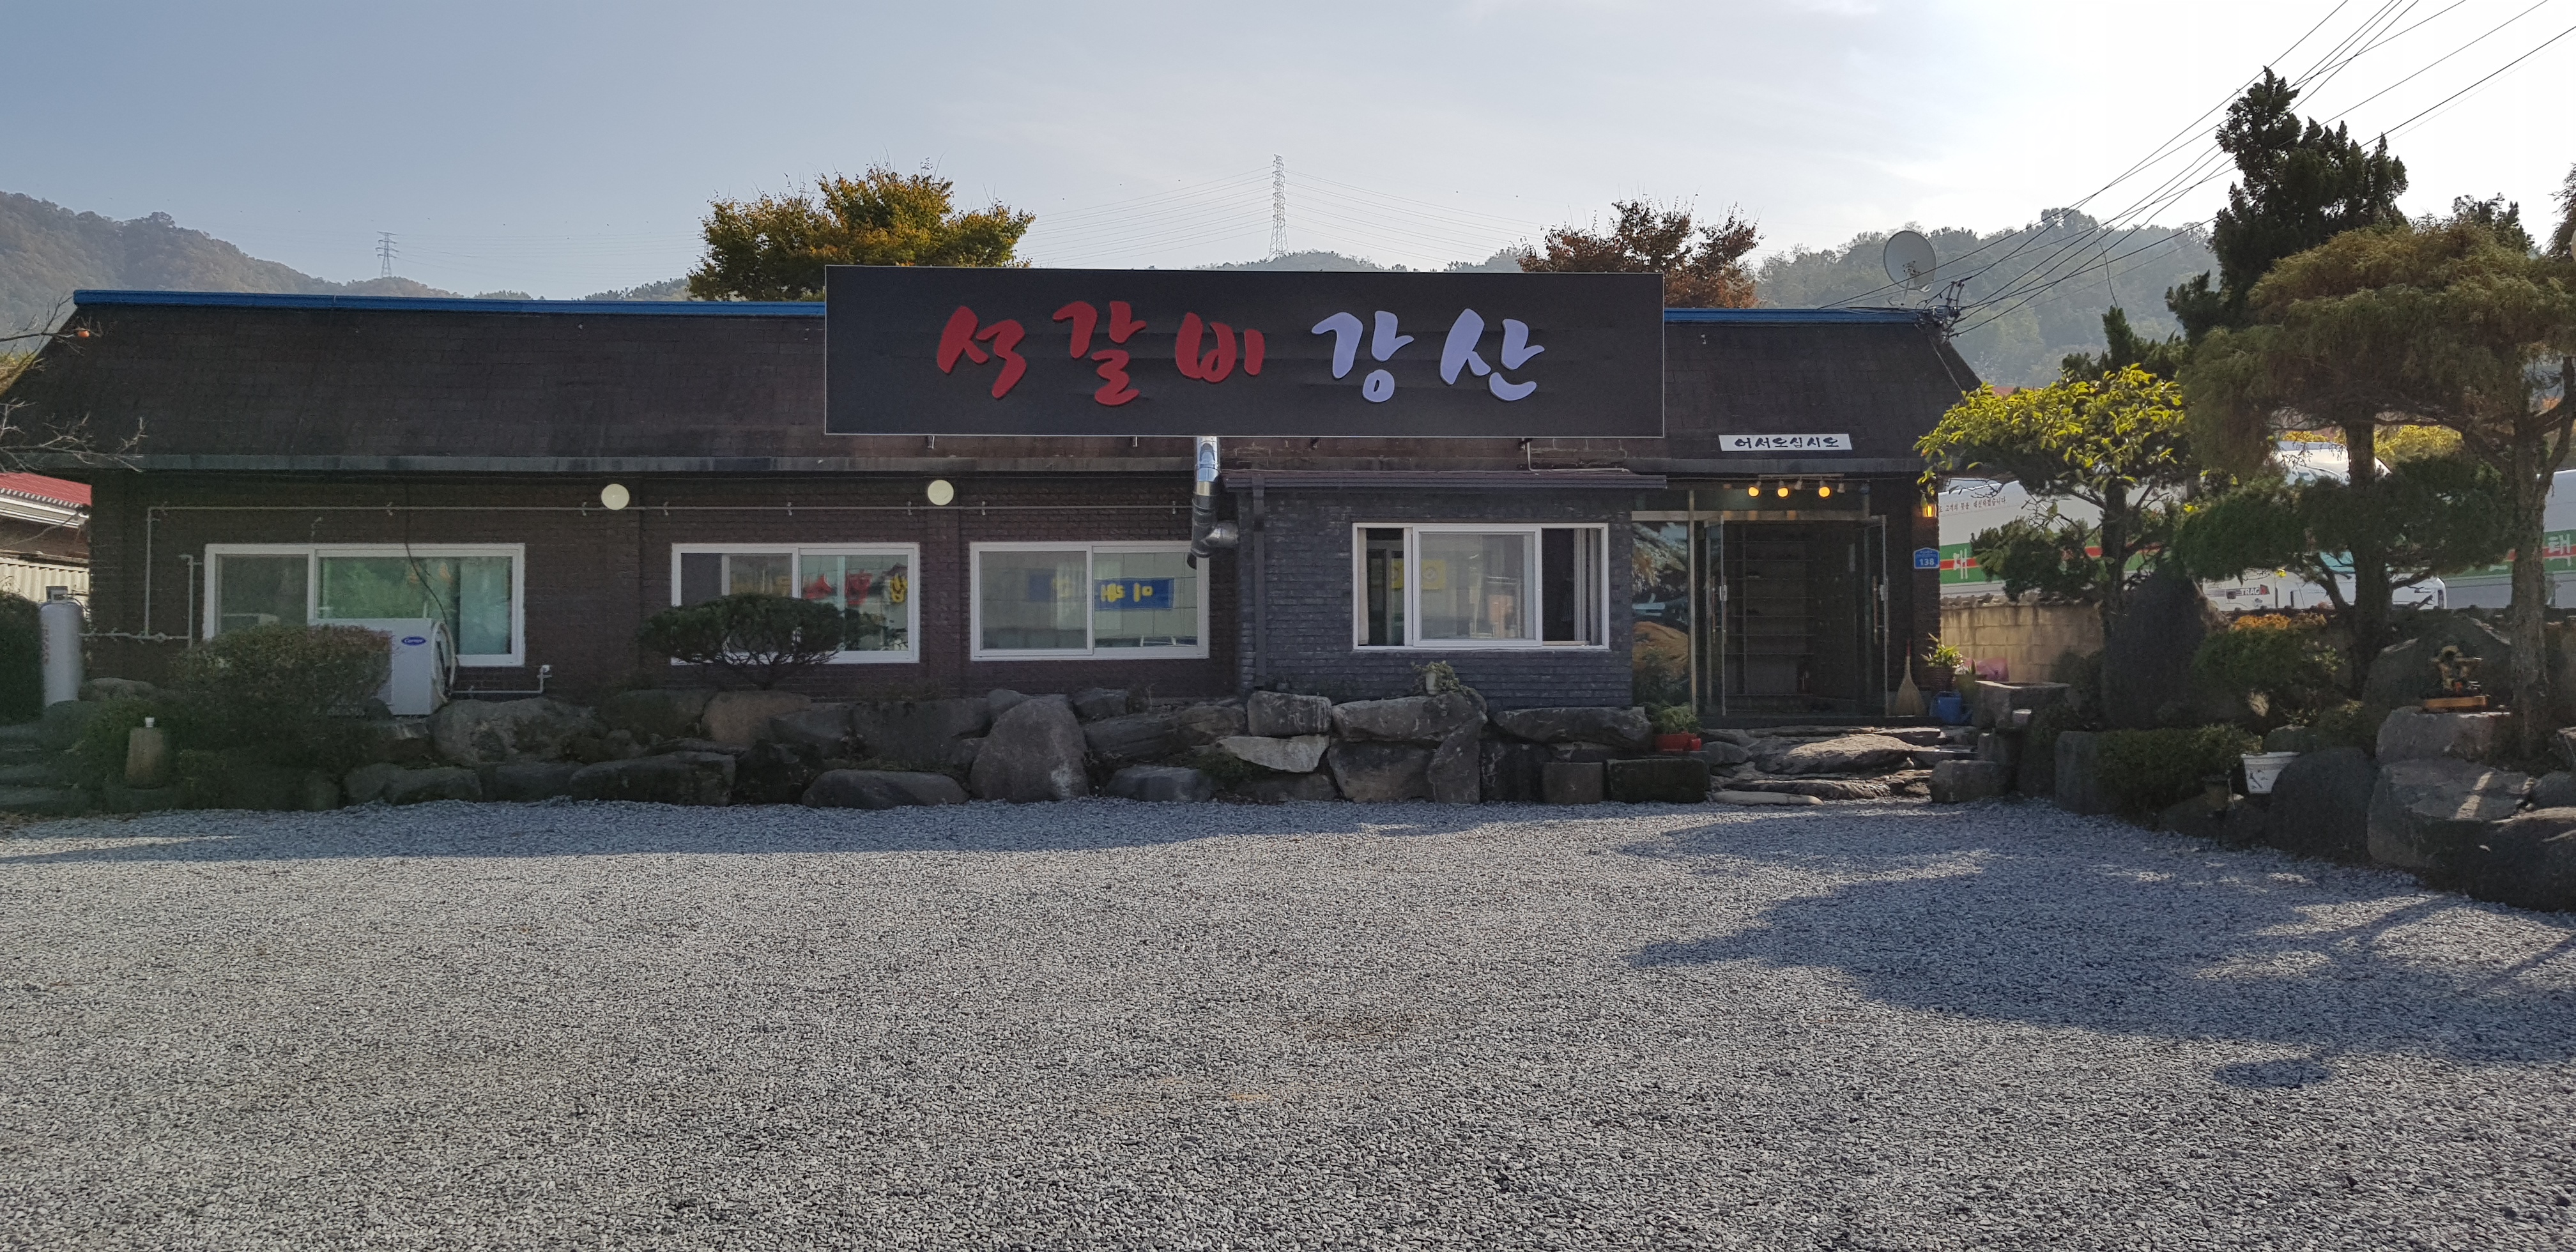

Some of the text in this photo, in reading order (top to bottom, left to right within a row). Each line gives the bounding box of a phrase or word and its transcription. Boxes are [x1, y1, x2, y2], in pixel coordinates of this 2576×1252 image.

[937, 301, 1544, 406] 석갈비 강산
[1735, 437, 1839, 448] 어서오십시오
